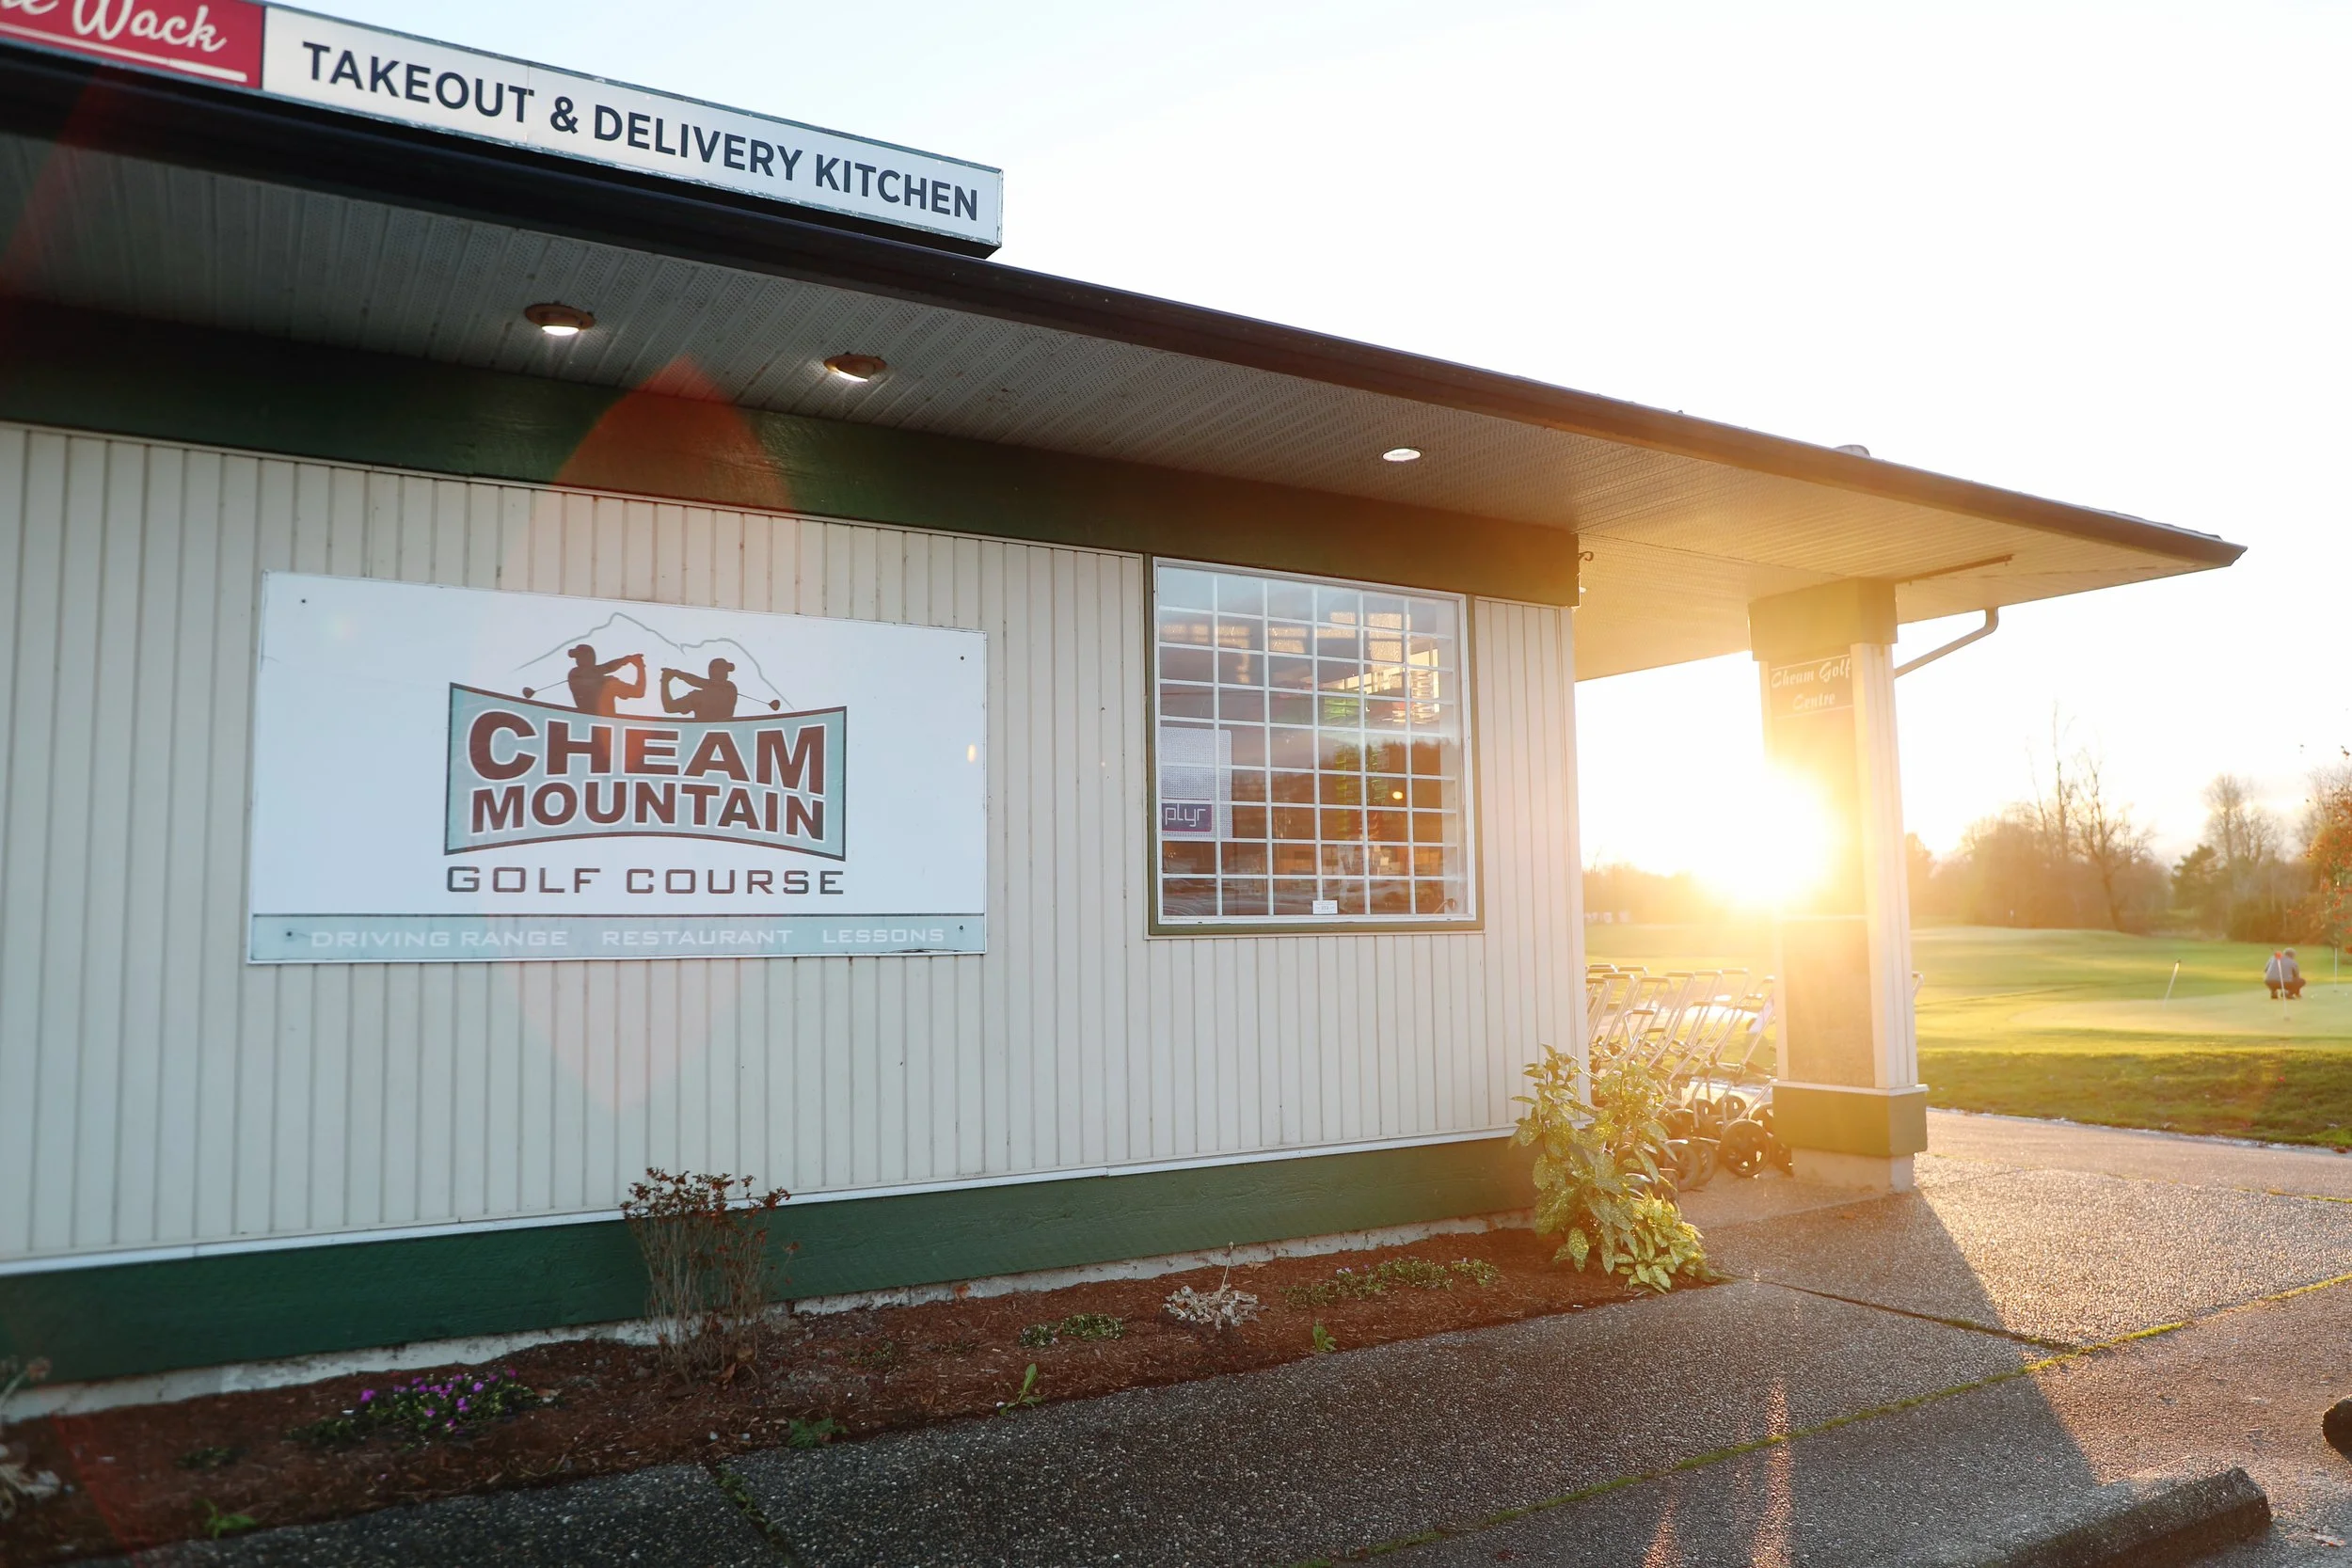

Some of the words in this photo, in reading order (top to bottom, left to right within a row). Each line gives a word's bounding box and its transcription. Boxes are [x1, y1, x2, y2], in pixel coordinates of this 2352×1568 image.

[72, 0, 227, 52] Wack
[302, 41, 534, 123] TAKEOUT
[549, 96, 579, 135] &
[594, 104, 803, 182] DELIVERY
[816, 153, 978, 221] KITCHEN
[1819, 657, 1851, 683] Golf
[1792, 692, 1836, 710] Centre
[469, 710, 825, 795] CHEAM
[472, 782, 825, 841] MOUNTAIN
[447, 865, 601, 894] GOLF
[627, 868, 844, 895] COURSE
[310, 930, 450, 948] DRIVING
[461, 930, 568, 946] RANGE
[602, 929, 793, 946] RESTAURANT
[822, 928, 945, 943] LESSONS
